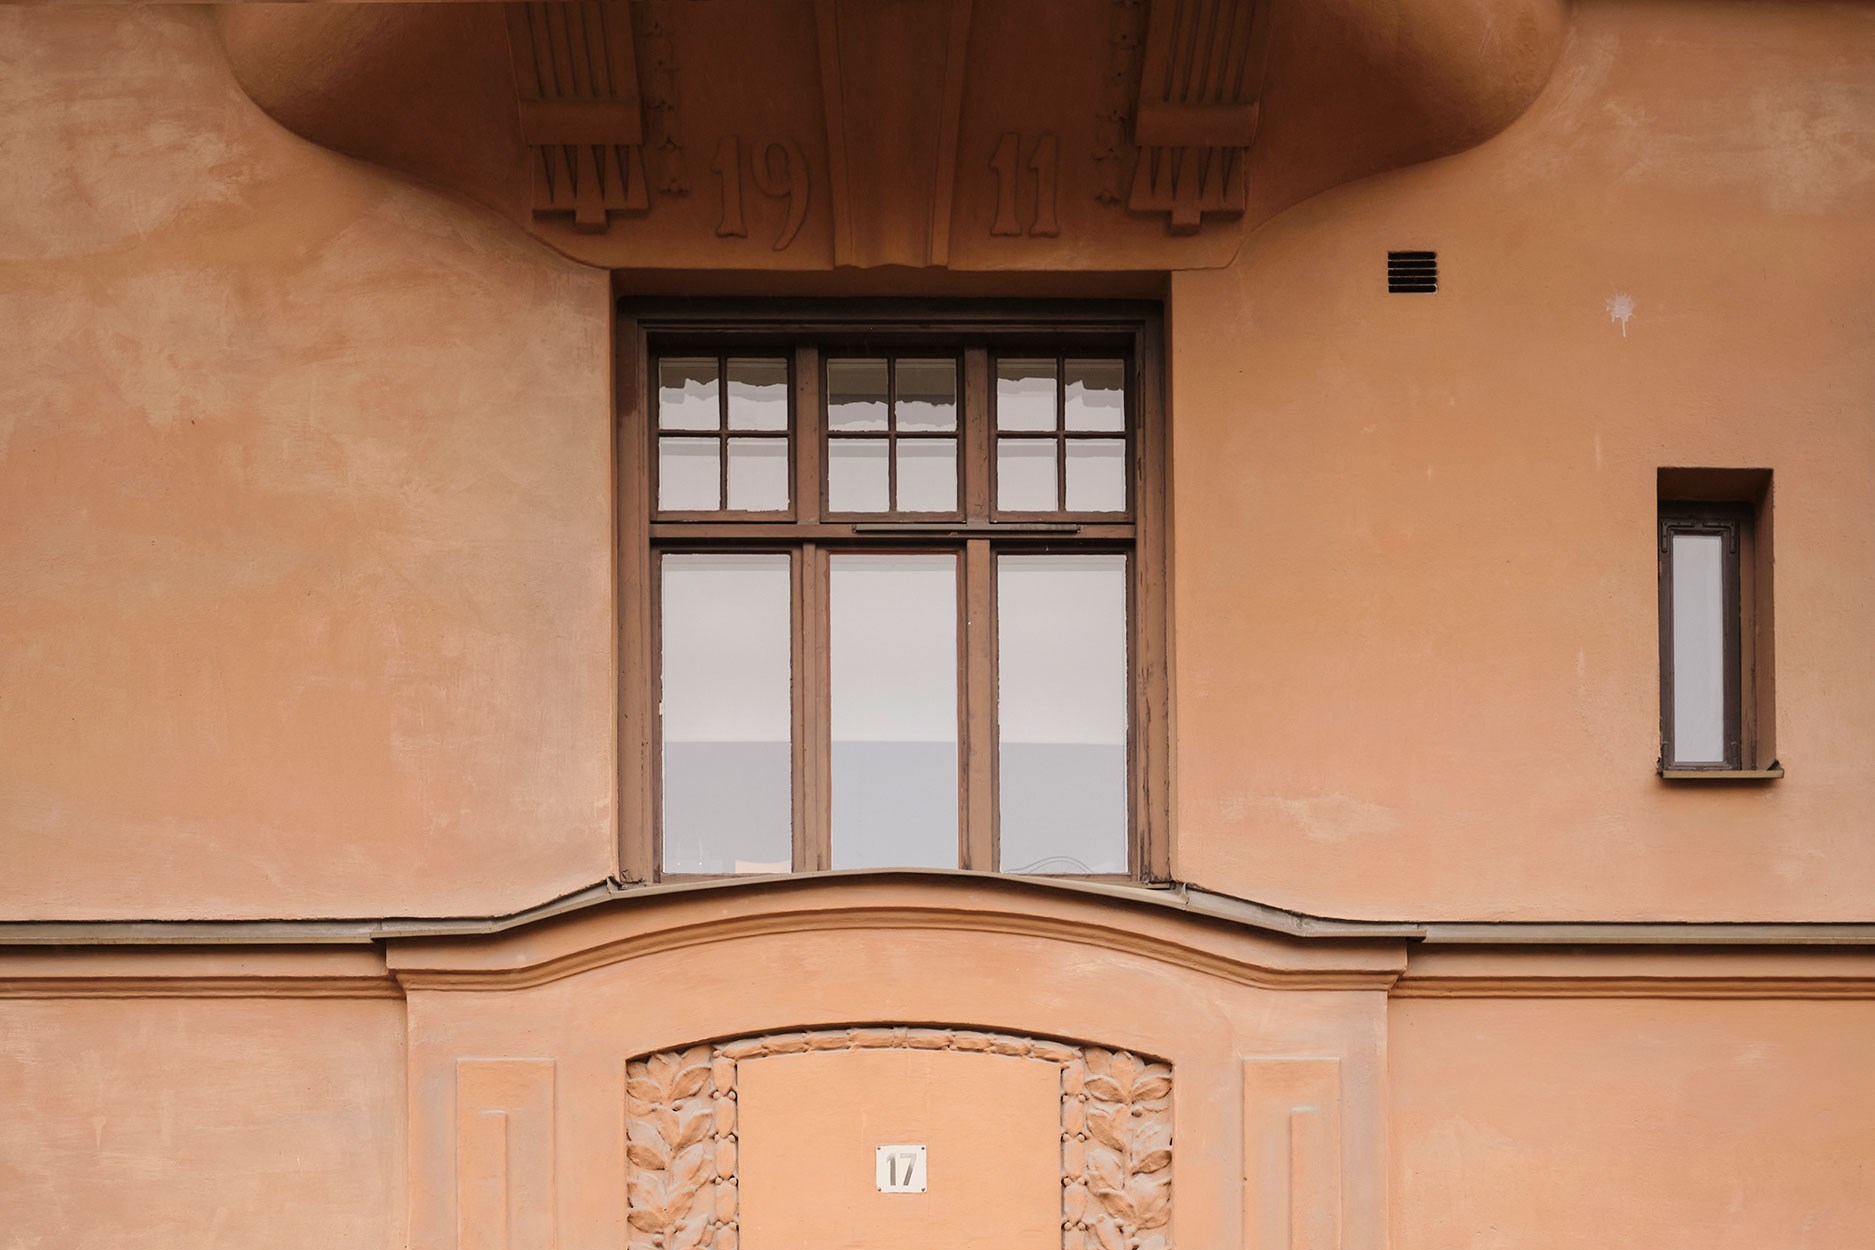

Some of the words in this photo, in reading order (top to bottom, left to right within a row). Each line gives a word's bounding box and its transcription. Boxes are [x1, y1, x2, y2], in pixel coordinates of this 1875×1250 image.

[710, 133, 812, 252] 19
[988, 131, 1060, 238] 11
[886, 1152, 917, 1186] 17
